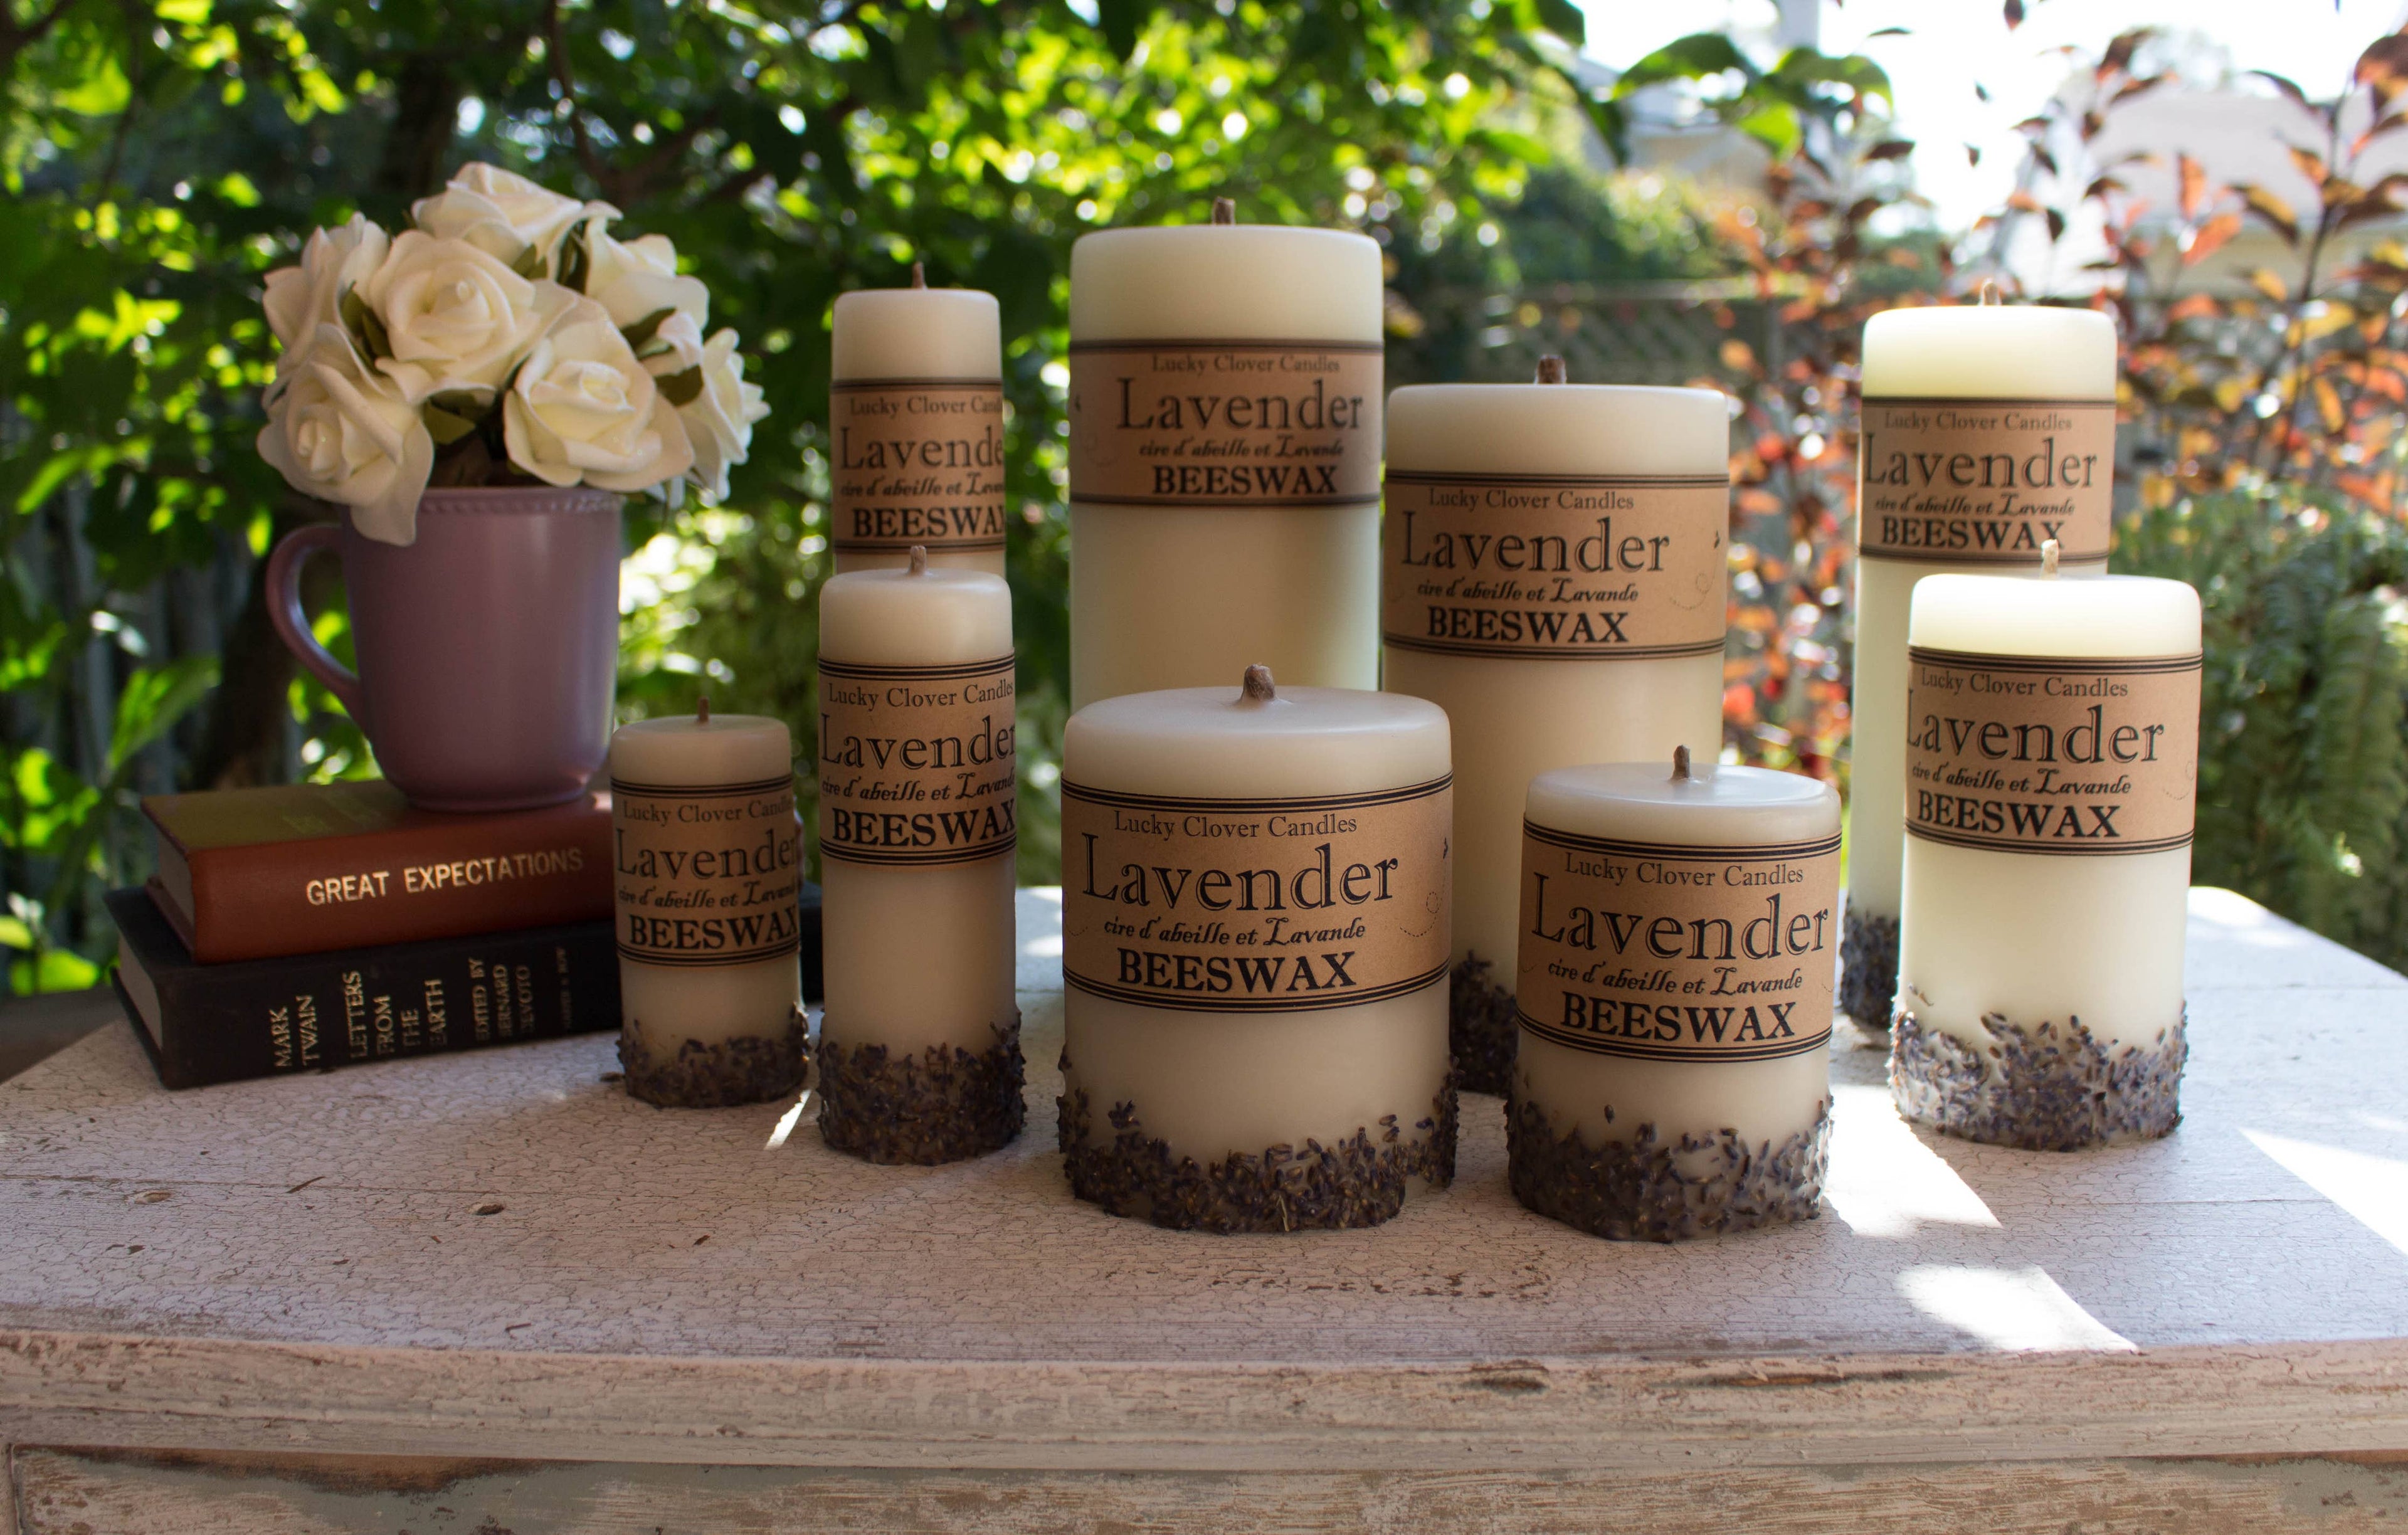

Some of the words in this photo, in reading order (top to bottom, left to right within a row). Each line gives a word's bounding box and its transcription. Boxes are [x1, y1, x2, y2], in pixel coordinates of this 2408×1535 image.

[1153, 355, 1207, 378] Lucky
[1214, 354, 1275, 374] Clover
[1279, 355, 1340, 372] Candles
[850, 396, 900, 418] Lucky
[907, 395, 966, 414] Clover
[1117, 377, 1363, 430] Lavender
[1885, 411, 1930, 434] Lucky
[1936, 411, 1998, 430] Clover
[2004, 412, 2073, 431] Candles
[840, 425, 1002, 469] Lavende
[1139, 441, 1169, 457] cire
[1254, 444, 1271, 456] et
[1864, 431, 2097, 488] Lavender
[946, 482, 962, 494] et
[1152, 465, 1338, 495] BEESWAX
[1430, 488, 1479, 512] Lucky
[1486, 489, 1551, 508] Clover
[1557, 491, 1634, 509] Candles
[1976, 502, 1993, 514] et
[1402, 511, 1670, 573] Lavender
[1882, 516, 2065, 551] BEESWAX
[1418, 579, 1442, 598] cire
[1526, 587, 1545, 601] et
[1550, 577, 1638, 603] Lavande
[1427, 606, 1629, 643] BEESWAX
[828, 682, 879, 711] Lucky
[887, 688, 957, 707] Clover
[964, 679, 1013, 704] Candles
[1922, 668, 1963, 695] Lucky
[1970, 674, 2036, 695] Clover
[2045, 677, 2127, 697] Candles
[821, 712, 1015, 770] Lavender
[1907, 689, 2164, 764] Lavender
[931, 785, 951, 800] et
[1913, 762, 1930, 781] cire
[2010, 777, 2029, 793] et
[2034, 768, 2131, 794] Lavande
[624, 801, 670, 826] Lucky
[678, 804, 742, 823] Clover
[832, 799, 1015, 847] BEESWAX
[1114, 810, 1175, 841] Lucky
[1183, 816, 1259, 838] Clover
[1268, 815, 1357, 837] Candles
[1918, 790, 2120, 838] BEESWAX
[307, 872, 389, 905] GREAT
[404, 848, 583, 894] EXPECTATIONS
[1082, 832, 1398, 911] Lavender
[1565, 852, 1628, 885] Lucky
[1637, 862, 1715, 885] Clover
[1724, 863, 1803, 886] Candles
[719, 894, 739, 907] et
[1531, 872, 1828, 960] Lavender
[1104, 918, 1134, 937] cire
[1236, 931, 1257, 946] et
[1263, 917, 1365, 946] Lavande
[468, 957, 485, 978] BY
[1117, 947, 1356, 993] BEESWAX
[1549, 959, 1577, 979] cire
[1682, 979, 1704, 994] et
[1710, 967, 1802, 995] Lavande
[296, 995, 320, 1065] TWAIN
[342, 970, 369, 1058] LETTERS
[373, 996, 395, 1057] FROM
[401, 1008, 421, 1048] THE
[425, 980, 447, 1048] EARTH
[472, 985, 490, 1041] EDITED
[1560, 991, 1796, 1042] BEESWAX
[269, 1006, 292, 1067] MARK
